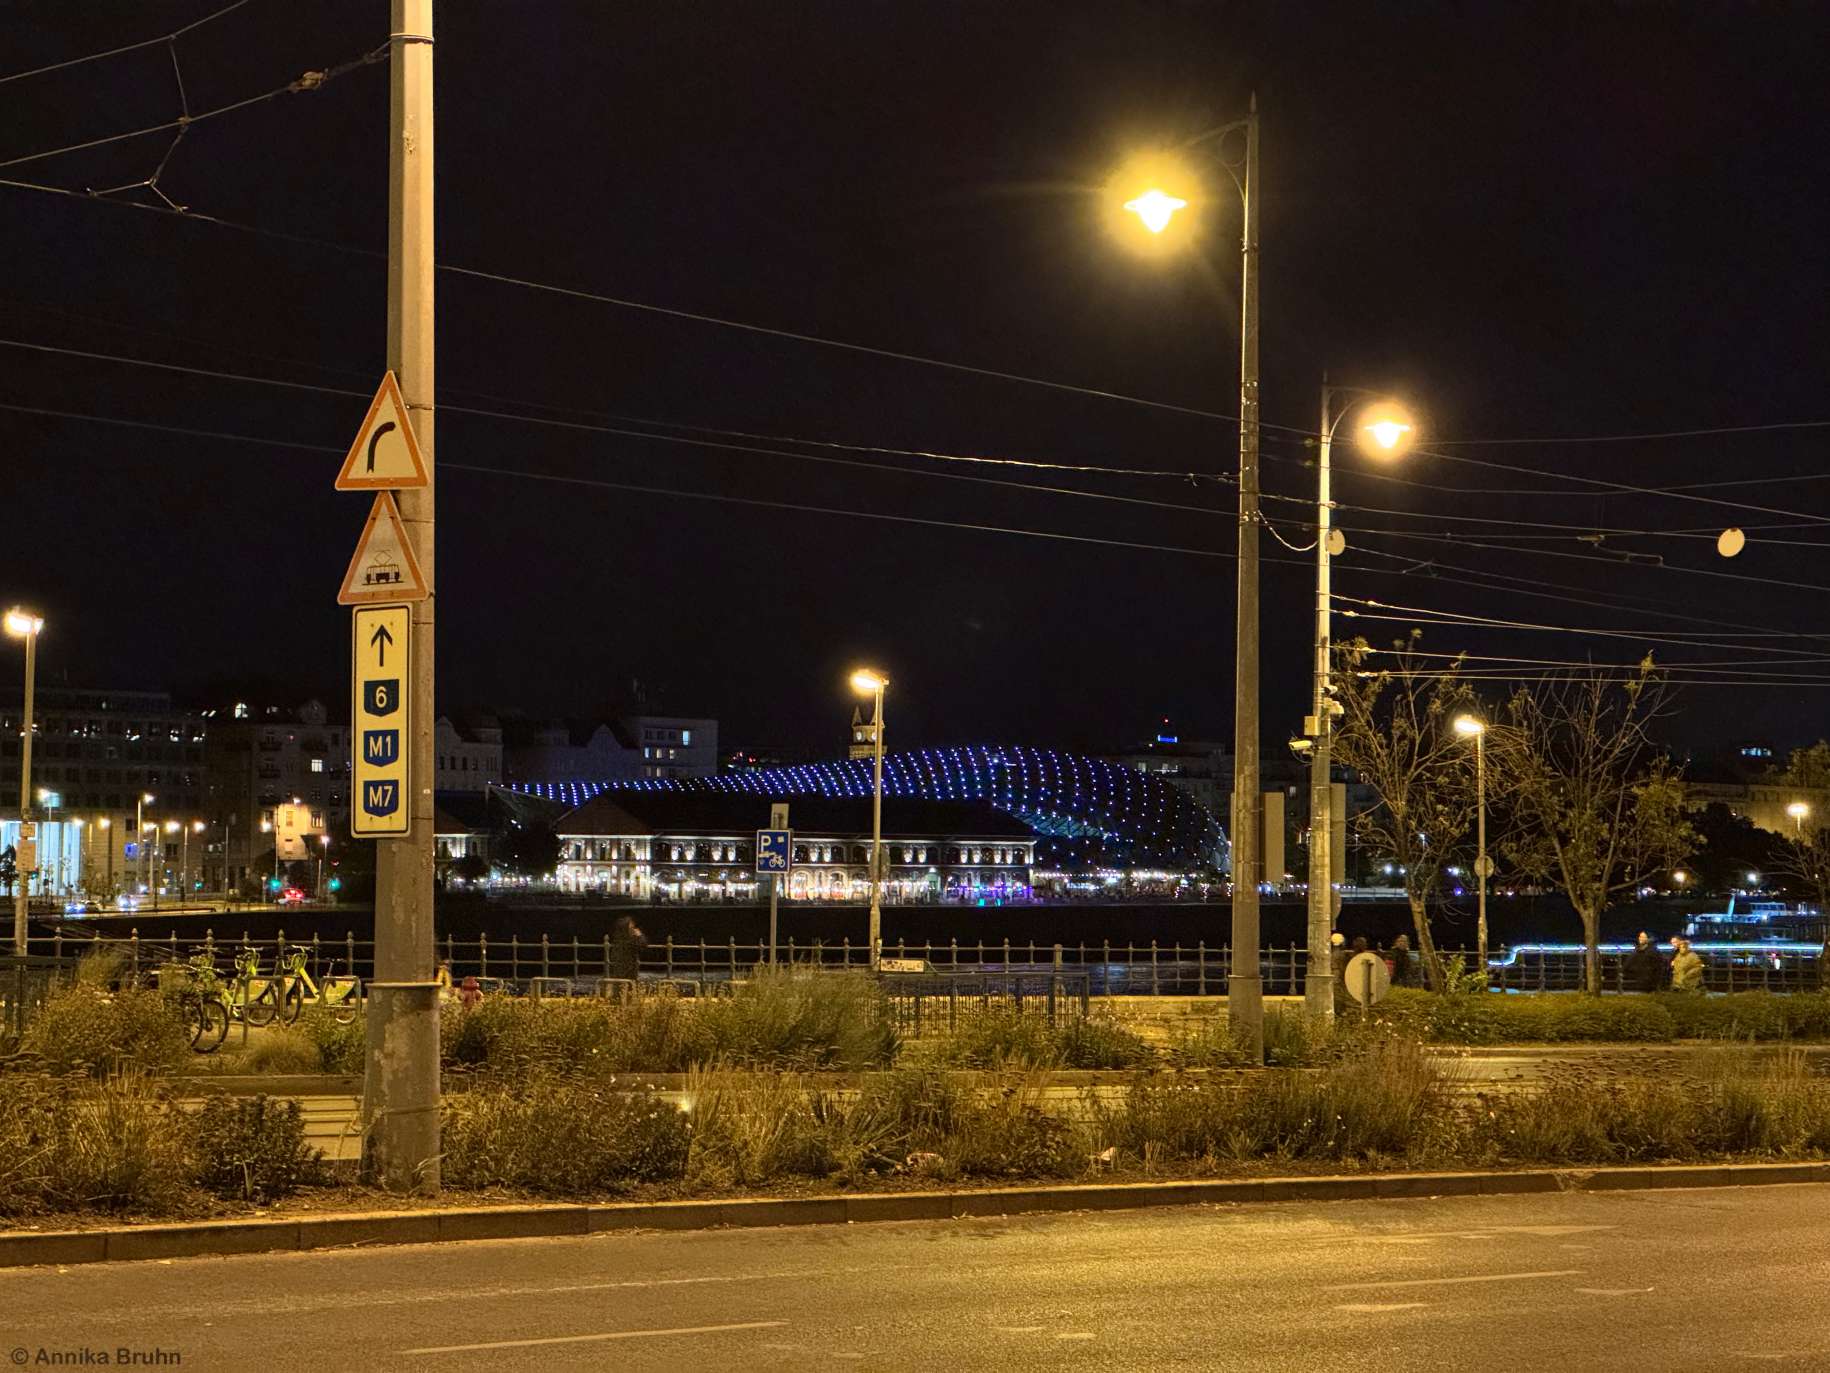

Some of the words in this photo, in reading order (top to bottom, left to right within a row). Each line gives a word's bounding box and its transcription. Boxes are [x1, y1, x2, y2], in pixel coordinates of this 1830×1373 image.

[375, 686, 387, 708] 6
[369, 735, 392, 758] M1
[369, 785, 393, 808] M7
[761, 835, 771, 852] P
